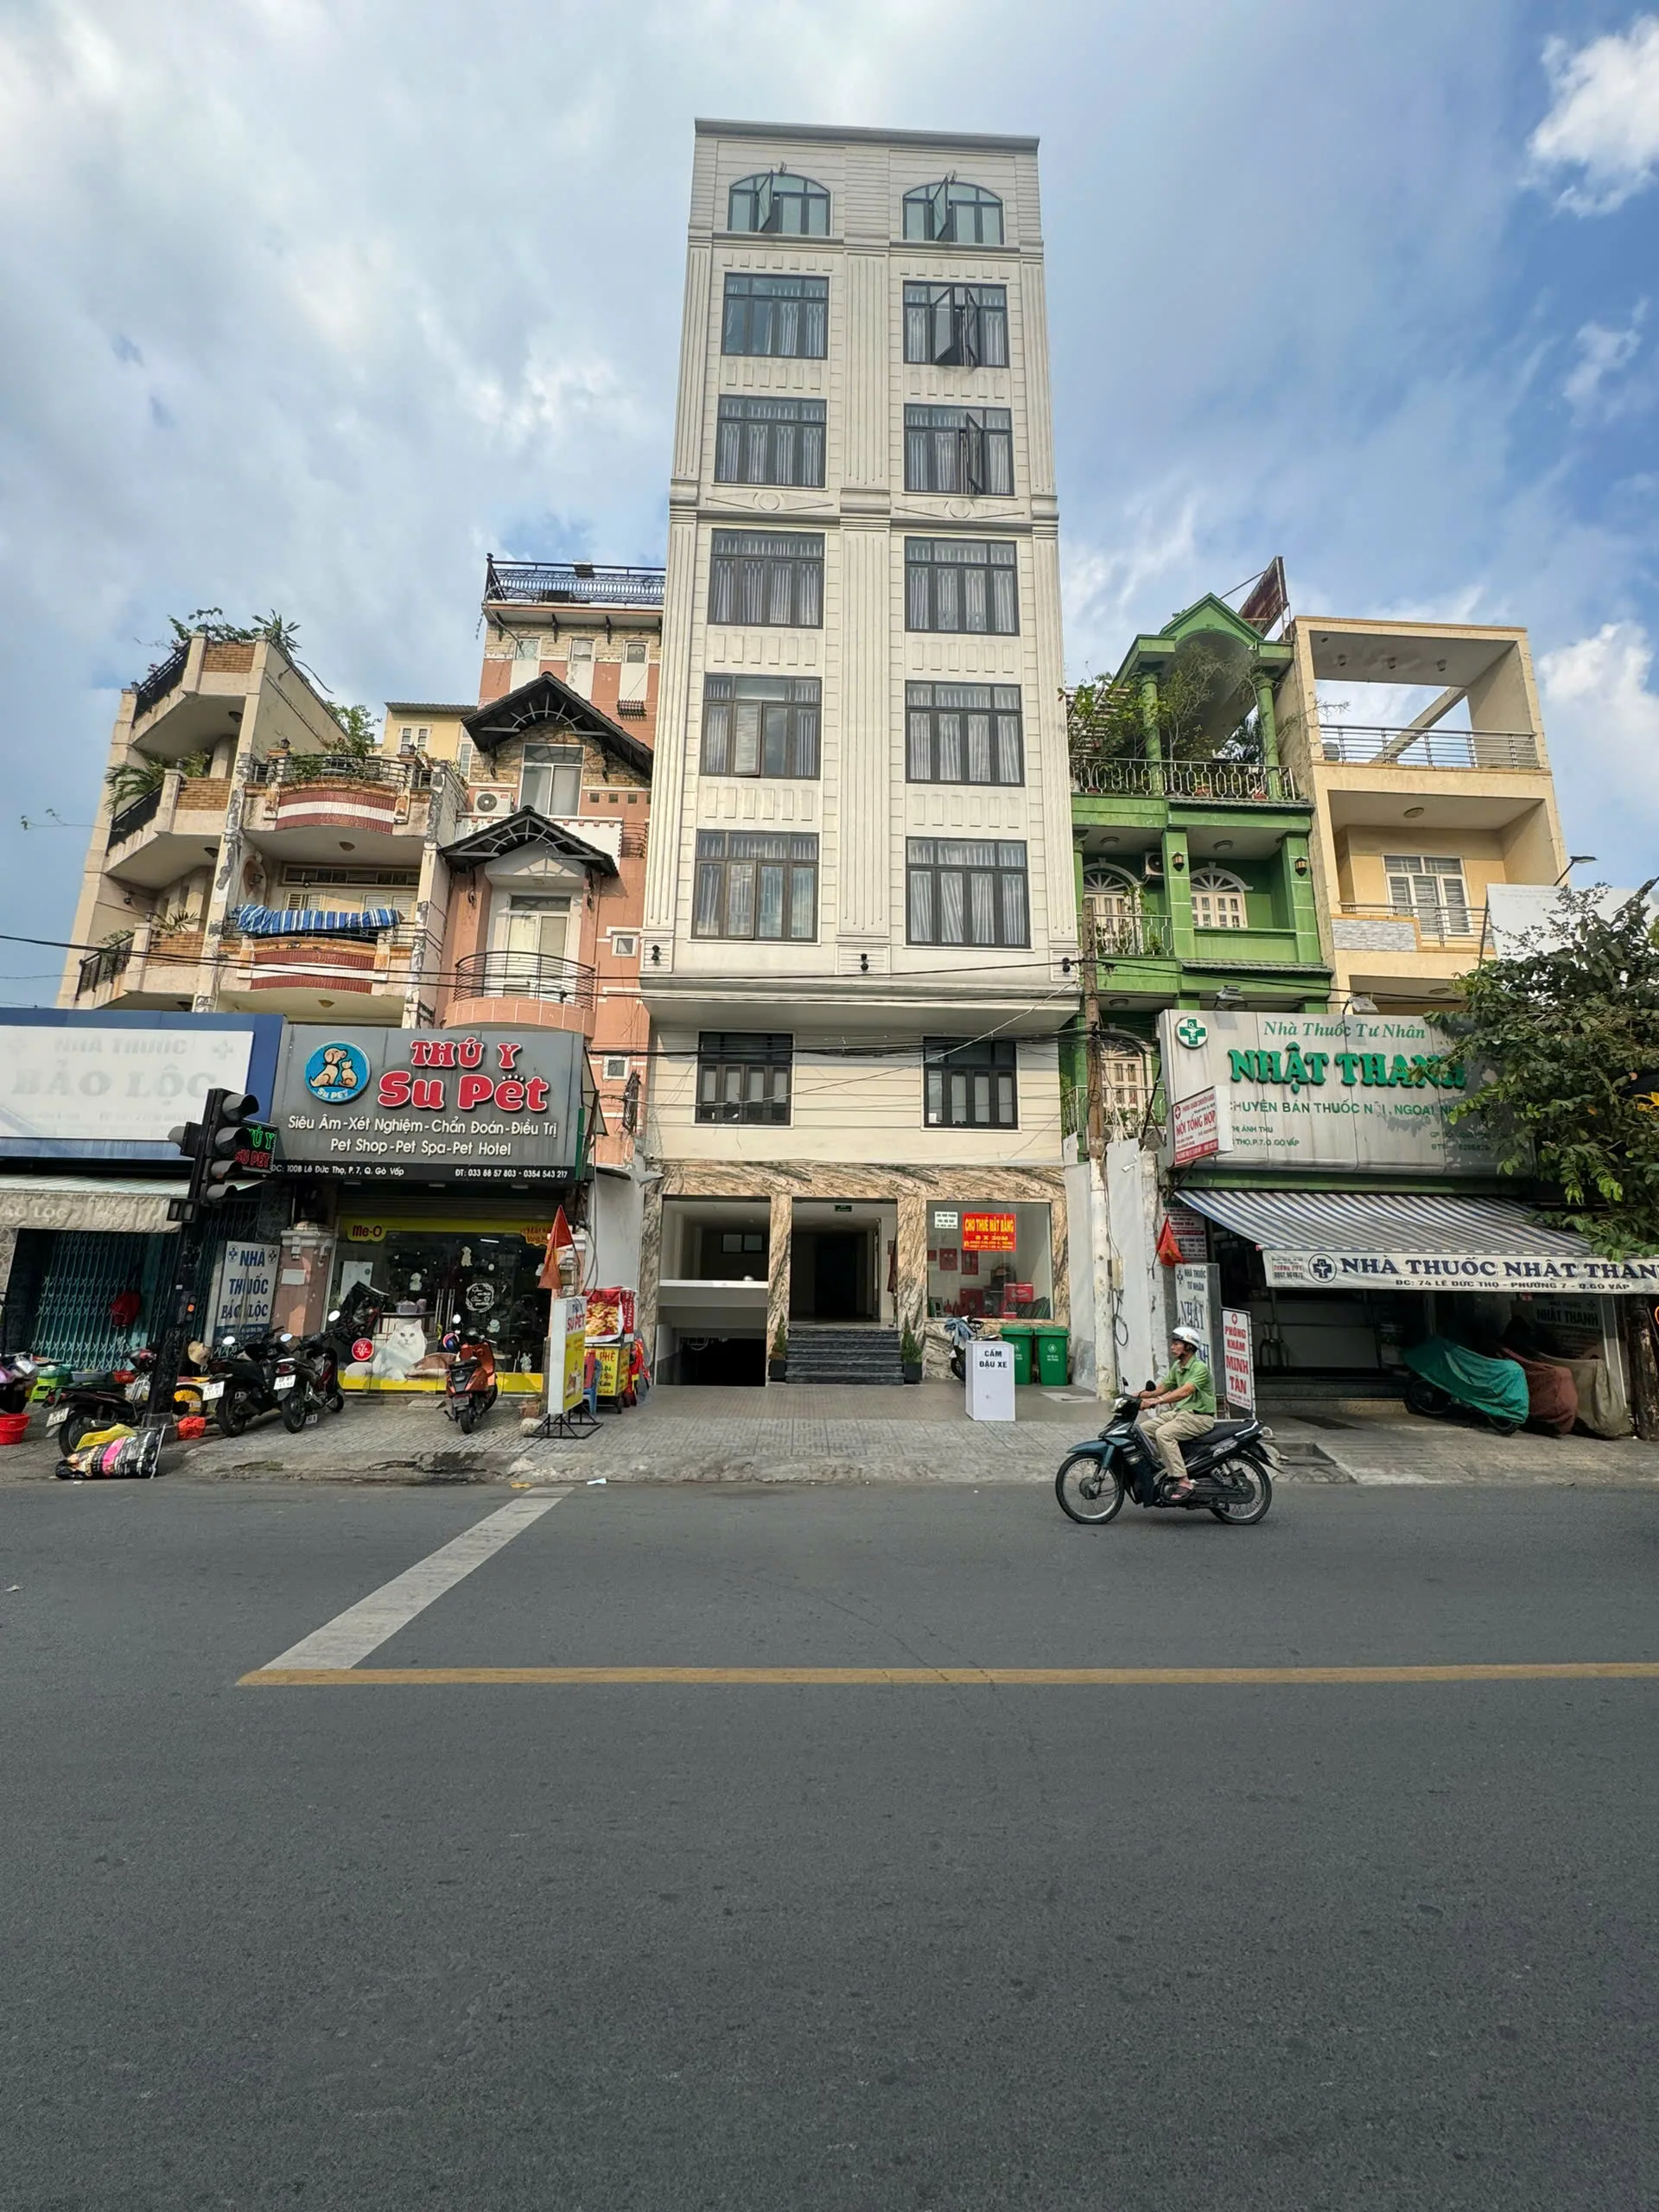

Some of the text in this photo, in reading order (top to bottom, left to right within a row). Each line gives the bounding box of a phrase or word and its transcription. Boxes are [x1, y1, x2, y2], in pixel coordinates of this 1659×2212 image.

[1263, 1020, 1425, 1039] Nhà Thuốc Tư Nhân
[410, 1038, 522, 1069] THÚ Y
[1227, 1041, 1330, 1095] NHẬT
[378, 1071, 550, 1111] Su Pet
[1230, 1099, 1277, 1113] HUYÊN
[288, 1116, 315, 1130] Siêu
[543, 1122, 557, 1138] Trị
[330, 1138, 352, 1152] Pet
[479, 1142, 512, 1156] Hotel
[482, 1169, 492, 1178] 88
[493, 1169, 502, 1178] 57
[542, 1170, 556, 1179] 543
[556, 1170, 568, 1179] 217
[352, 1224, 383, 1237] Me-O
[239, 1248, 265, 1267] NHÀ
[1339, 1255, 1659, 1281] NHÀ THUỐC NHẬT THAN
[229, 1273, 269, 1295] THUỐC
[248, 1300, 269, 1321] LỘC
[984, 1347, 1002, 1357] CẤM
[1225, 1355, 1249, 1375] MINH
[1229, 1375, 1247, 1395] TÂN
